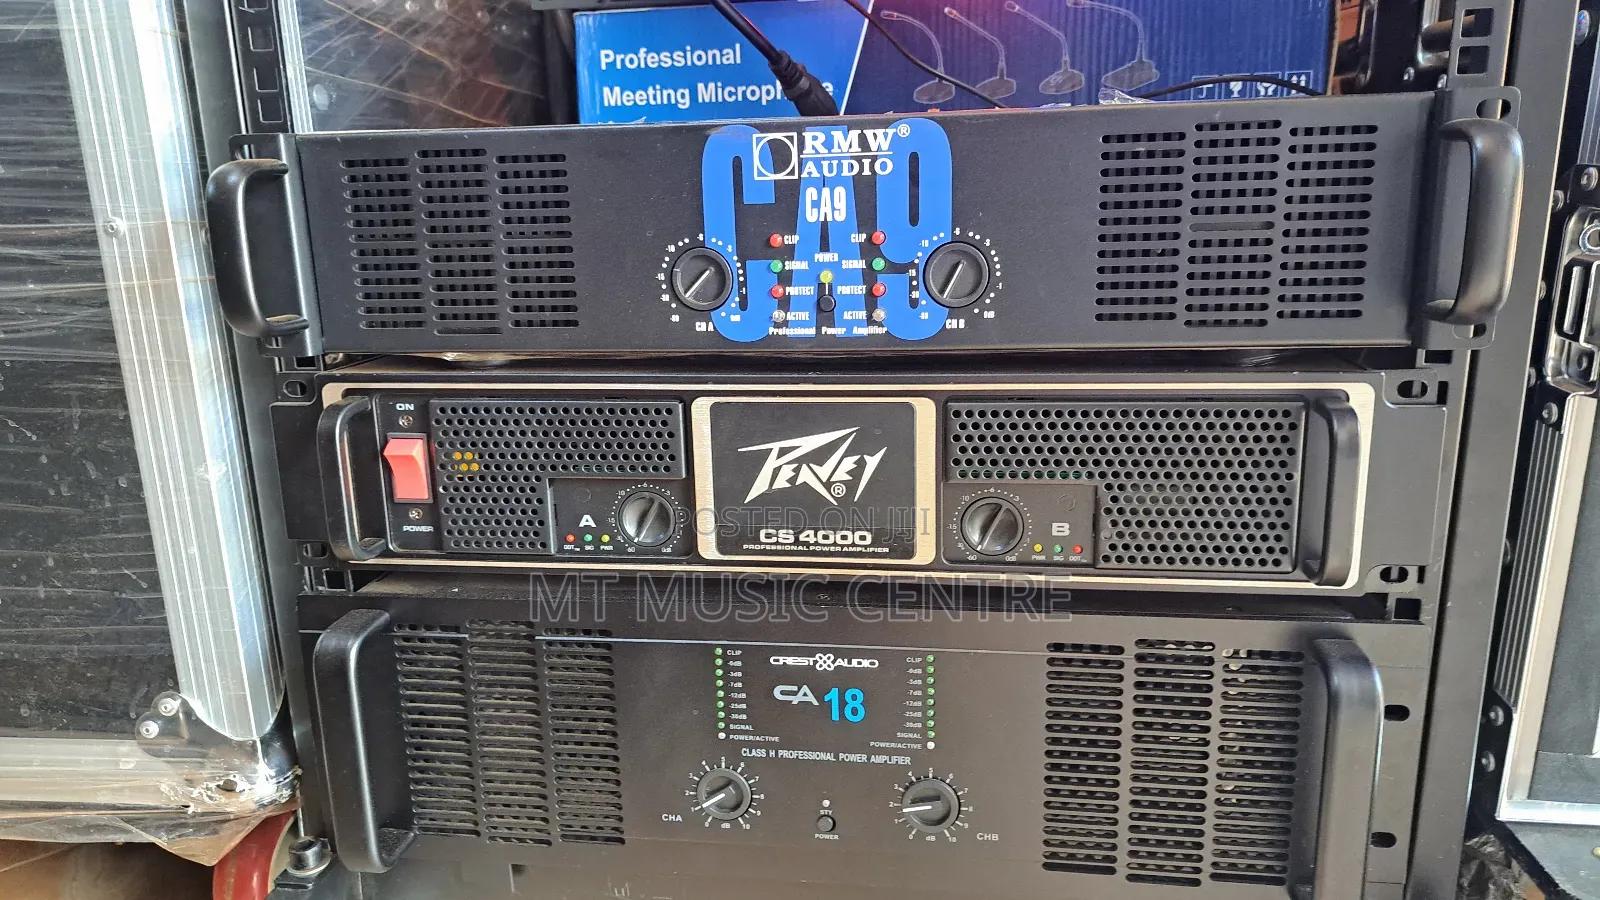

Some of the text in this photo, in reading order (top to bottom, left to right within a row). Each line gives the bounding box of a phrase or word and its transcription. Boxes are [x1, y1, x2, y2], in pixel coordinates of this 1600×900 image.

[600, 44, 741, 70] Professional
[603, 80, 834, 109] Meeting Microphe
[800, 158, 894, 177] AUDIO
[805, 186, 846, 222] CA9
[784, 235, 800, 244] CLIP
[851, 234, 866, 242] CLIP
[814, 253, 838, 262] POWER
[785, 261, 809, 270] SIGNAL
[842, 260, 866, 268] SIGNAL
[786, 286, 814, 295] PROTECT
[837, 285, 866, 294] PROTECT
[786, 312, 810, 320] ACTIVE
[843, 311, 867, 320] ACTIVE
[946, 319, 958, 328] CH
[768, 326, 888, 335] Professional Power Amplifier
[738, 426, 888, 506] PEAVEY
[578, 514, 596, 528] A
[1052, 522, 1070, 536] B
[760, 529, 872, 545] CS 4000
[770, 656, 880, 668] CREST AUDIO
[773, 684, 866, 722] CA 18
[730, 734, 780, 742] POWER/ACTIVE
[741, 748, 912, 766] CLASS H PROFESSIONAL POWER AMPLIFIER
[662, 814, 682, 822] CHA
[976, 832, 999, 840] CHB
